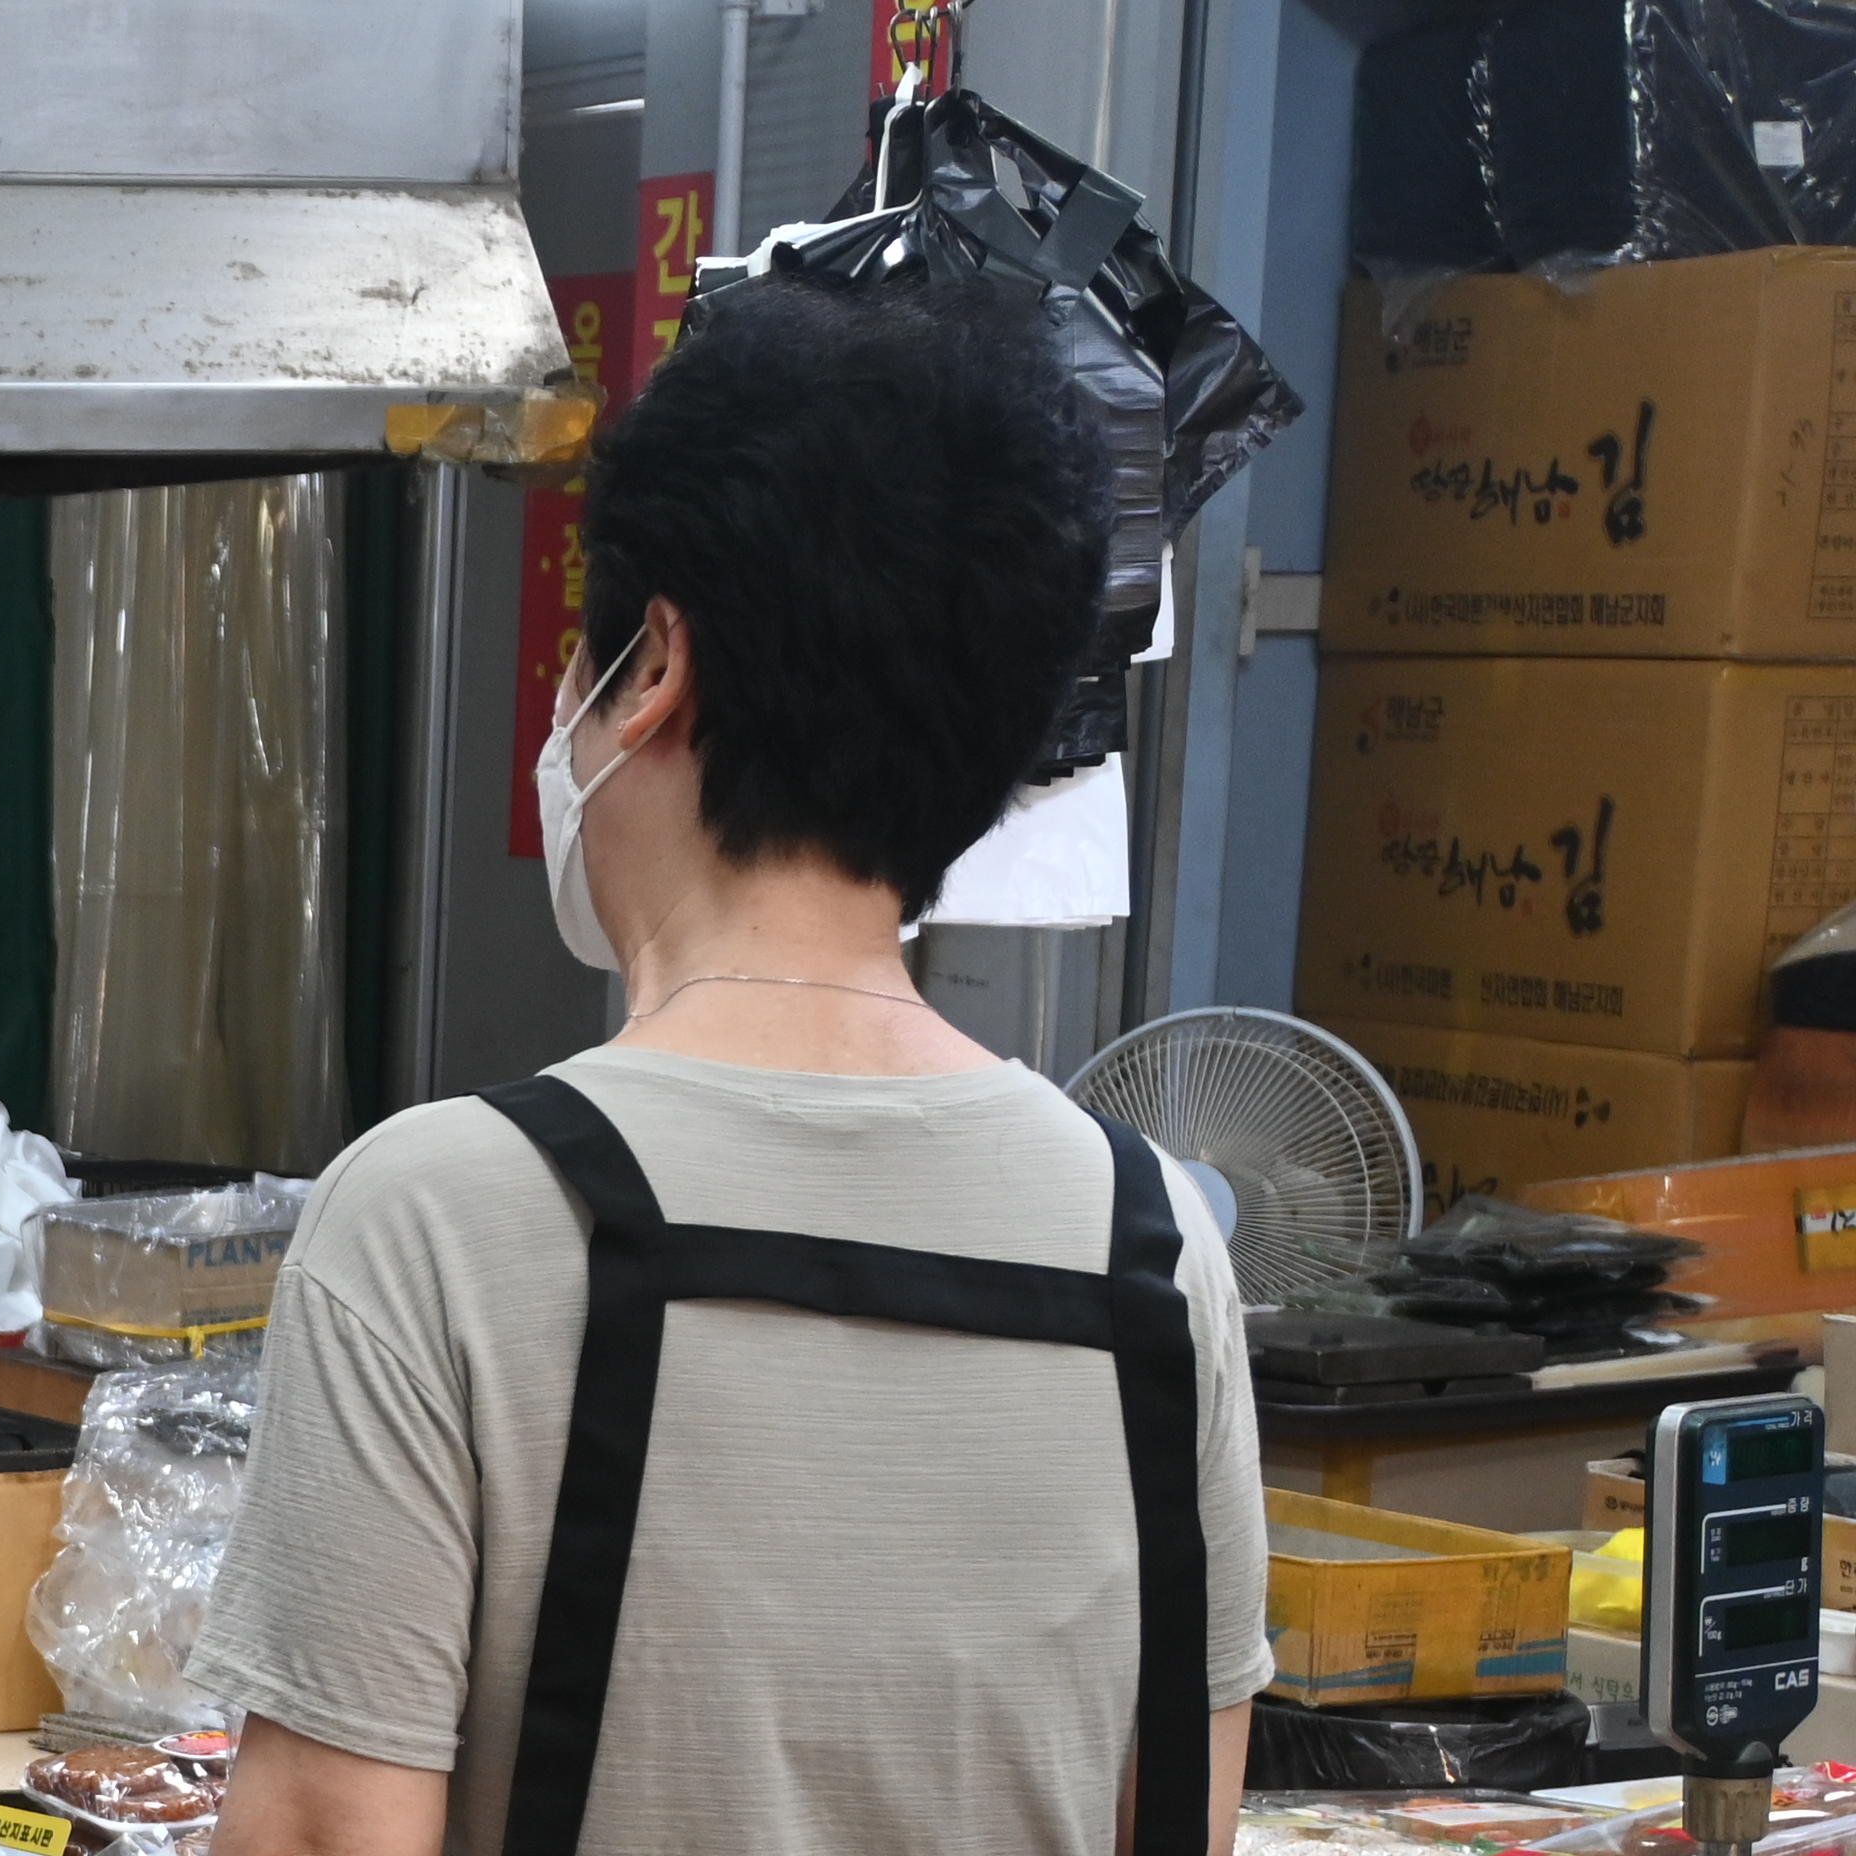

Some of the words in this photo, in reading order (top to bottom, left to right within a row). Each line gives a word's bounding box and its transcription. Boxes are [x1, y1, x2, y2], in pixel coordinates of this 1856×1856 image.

[1587, 398, 1655, 547] 김
[1551, 795, 1614, 937] 김
[1592, 1676, 1635, 1701] 식탁으
[1775, 1668, 1809, 1690] CAS
